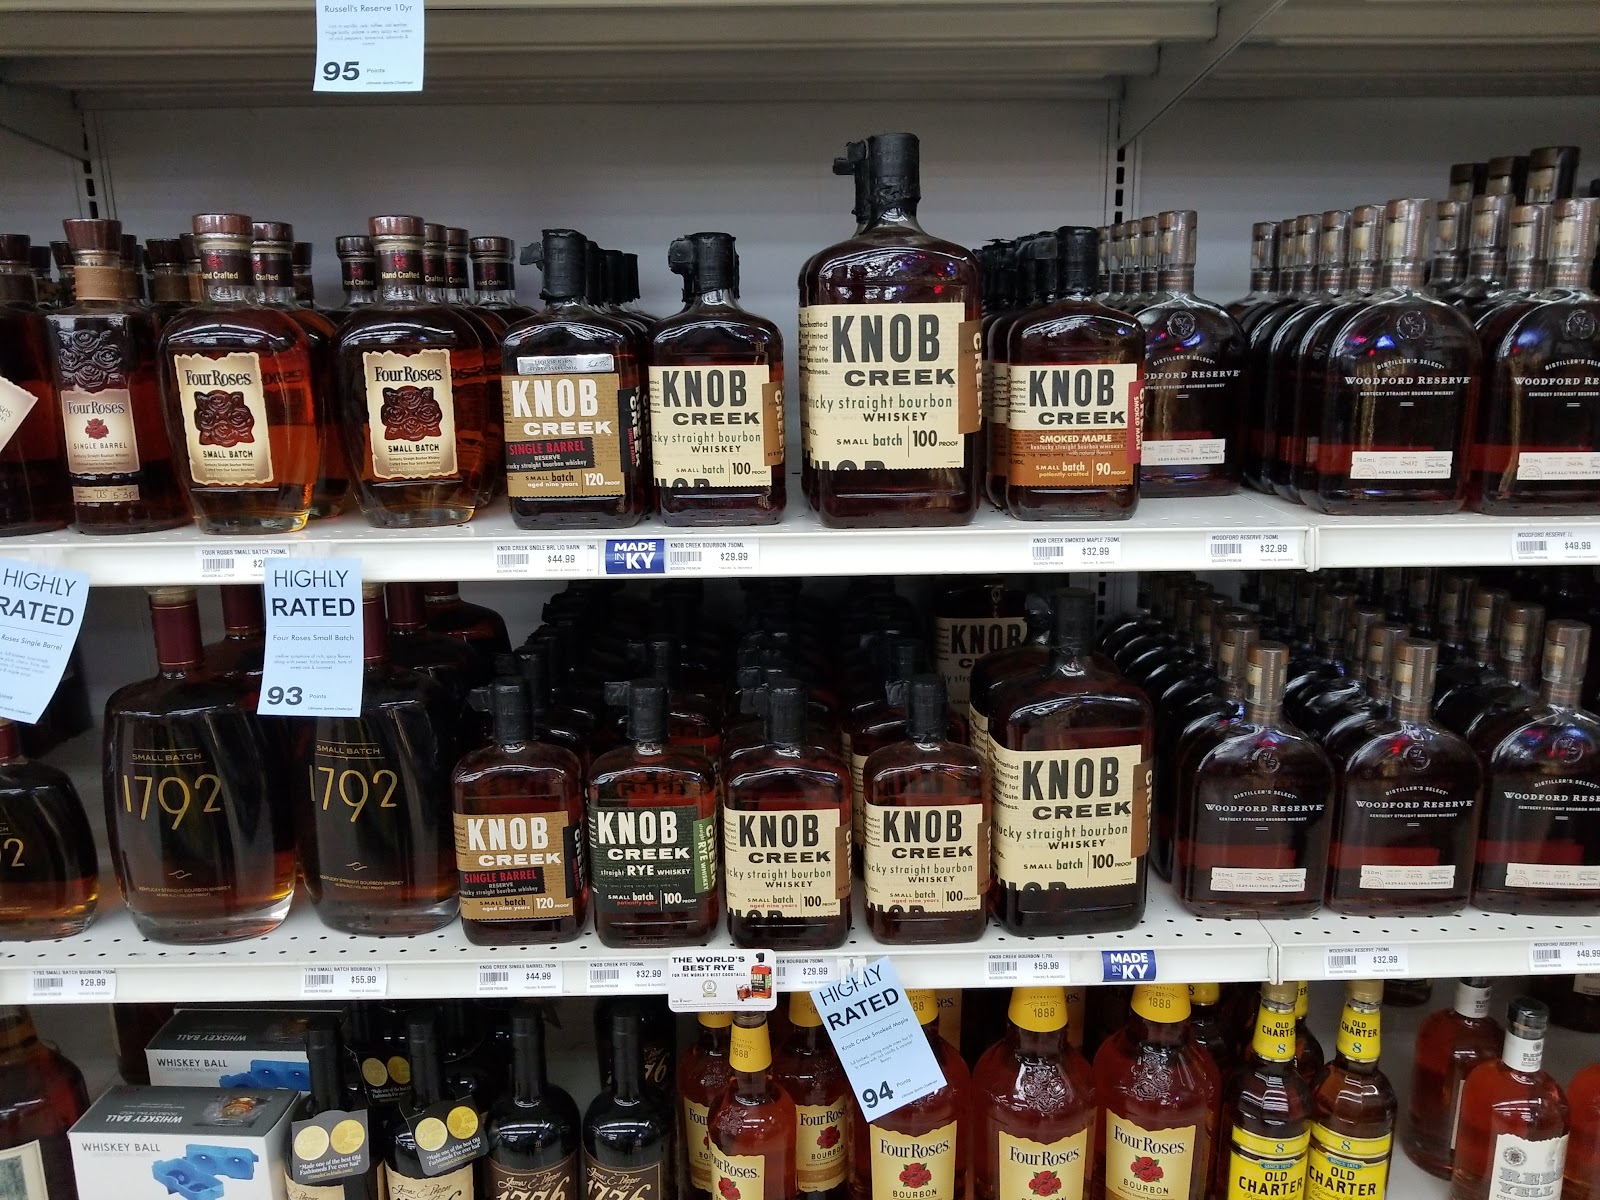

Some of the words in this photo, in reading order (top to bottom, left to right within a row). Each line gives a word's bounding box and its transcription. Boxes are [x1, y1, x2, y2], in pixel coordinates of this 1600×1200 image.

[323, 61, 360, 82] 95
[832, 314, 940, 364] KNOB
[844, 368, 956, 387] CREEK
[1191, 370, 1240, 379] RESERVE
[1344, 376, 1414, 386] WOODFORD
[1418, 376, 1471, 385] RESERVE
[1514, 376, 1581, 386] WOODFORD
[662, 370, 746, 408] KNOB
[1028, 368, 1114, 408] KNOB
[512, 378, 598, 418] KNOB
[838, 394, 893, 412] straight
[900, 392, 952, 408] bourbon
[672, 412, 760, 426] CREEK
[863, 412, 928, 422] WHISKEY
[1038, 410, 1126, 426] CREEK
[523, 420, 613, 436] CREEK
[672, 431, 715, 446] straight
[718, 430, 761, 443] bourbon
[836, 438, 869, 446] SMALL
[872, 434, 902, 446] batch
[912, 430, 938, 448] 100
[1040, 435, 1080, 443] SMOKED
[1082, 434, 1112, 442] MAPLE
[73, 442, 96, 450] SINGLE
[100, 442, 128, 450] BARREL
[388, 444, 412, 453] SMALL
[415, 444, 440, 452] BATCH
[509, 442, 542, 455] SINGLE
[546, 440, 586, 452] BARREL
[690, 445, 742, 453] WHISKEY
[202, 450, 226, 458] SMALL
[229, 450, 253, 458] BATCH
[702, 464, 725, 474] batch
[732, 462, 751, 475] 100
[1062, 461, 1086, 472] batch
[1096, 462, 1111, 476] 90
[551, 472, 574, 482] batch
[584, 473, 604, 487] 120
[614, 542, 656, 552] MADE
[1082, 547, 1110, 556] $32.99
[1260, 544, 1288, 554] $32.99
[548, 554, 576, 564] $44.99
[614, 554, 624, 562] IN
[626, 552, 654, 570] KY
[720, 552, 748, 562] $29.99
[3, 568, 77, 596] HIGHLY
[274, 570, 349, 588] HIGHLY
[0, 596, 74, 626] RATED
[272, 598, 355, 617] RATED
[266, 686, 303, 706] 93
[316, 744, 345, 754] SMALL
[346, 747, 380, 756] BATCH
[132, 753, 164, 762] SMALL
[165, 752, 202, 761] BATCH
[1022, 756, 1119, 800] KNOB
[123, 773, 222, 830] 1792
[1504, 791, 1568, 802] WOODFORD
[1032, 802, 1132, 820] CREEK
[1205, 803, 1268, 812] WOODFORD
[1271, 804, 1324, 812] RESERVE
[1356, 800, 1420, 810] WOODFORD
[1423, 800, 1474, 808] RESERVE
[466, 816, 548, 850] KNOB
[598, 811, 678, 845] KNOB
[738, 814, 819, 848] KNOB
[883, 810, 962, 844] KNOB
[1026, 822, 1076, 842] straight
[1080, 822, 1128, 838] bourbon
[1048, 838, 1106, 850] WHISKEY
[607, 848, 690, 861] CREEK
[748, 850, 831, 864] CREEK
[891, 846, 973, 859] CREEK
[478, 852, 562, 867] CREEK
[1023, 862, 1052, 870] SMALL
[1056, 858, 1083, 870] batch
[1092, 853, 1114, 868] 100
[600, 868, 625, 877] straight
[626, 865, 654, 876] RYE
[656, 868, 690, 876] WHISKEY
[747, 868, 788, 881] straight
[792, 868, 831, 879] bourbon
[890, 863, 932, 876] straight
[934, 862, 973, 874] bourbon
[464, 872, 496, 884] SINGLE
[500, 869, 537, 881] BARREL
[908, 876, 955, 884] WHISKEY
[765, 880, 813, 888] WHISKEY
[632, 892, 654, 902] batch
[663, 892, 682, 904] 100
[772, 895, 794, 904] batch
[914, 890, 936, 899] batch
[946, 890, 962, 902] 100
[504, 898, 526, 906] batch
[536, 898, 554, 910] 120
[803, 896, 822, 908] 100
[672, 956, 692, 964] THE
[1110, 952, 1148, 964] MADE
[1372, 956, 1398, 964] $32.99
[636, 969, 662, 978] $32.99
[682, 964, 711, 972] BEST
[802, 967, 828, 976] $29.99
[1112, 965, 1122, 973] IN
[1122, 964, 1148, 980] KY
[80, 978, 106, 988] $29.99
[526, 972, 552, 982] $44.99
[826, 987, 900, 1031] RATED
[1352, 1020, 1366, 1028] OLD
[1277, 1042, 1286, 1054] 8
[1352, 1042, 1362, 1054] 8
[156, 1058, 200, 1067] WHISKEY
[202, 1059, 228, 1068] BALL
[862, 1080, 895, 1110] 94
[82, 1142, 130, 1152] WHISKEY
[134, 1143, 160, 1152] BALL
[1264, 1172, 1288, 1182] OLD
[1330, 1166, 1355, 1180] OLD
[1124, 1178, 1169, 1194] BOURBON
[1309, 1166, 1376, 1196] CHARTER
